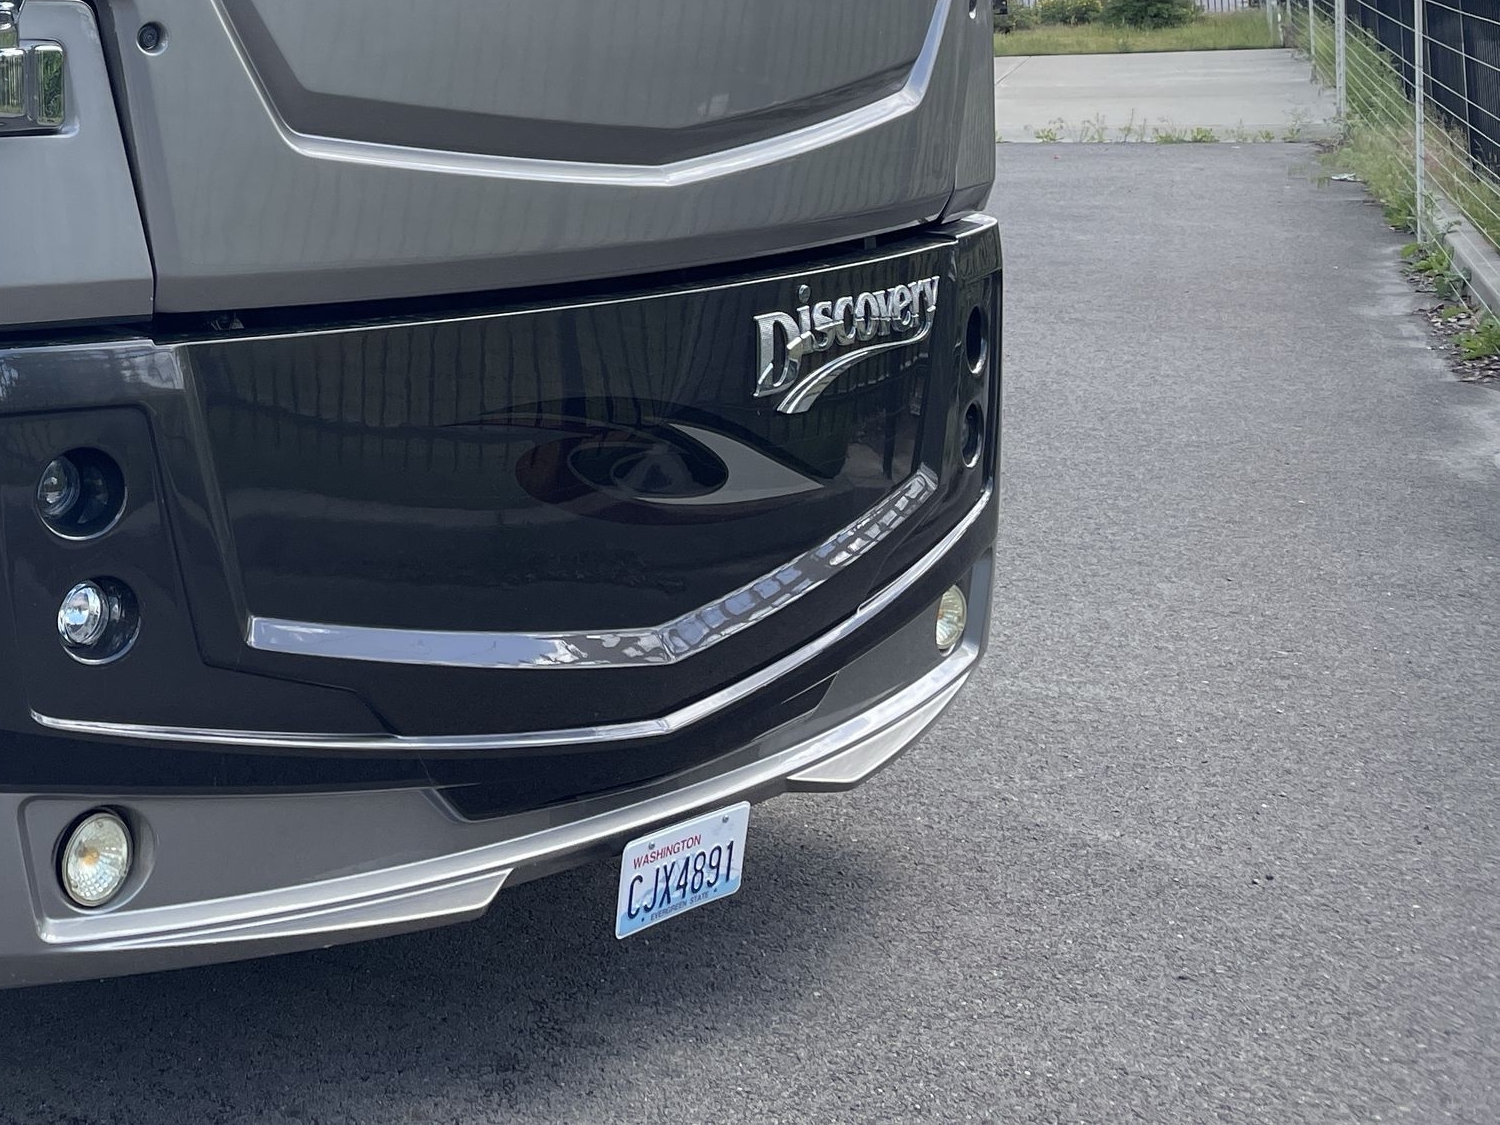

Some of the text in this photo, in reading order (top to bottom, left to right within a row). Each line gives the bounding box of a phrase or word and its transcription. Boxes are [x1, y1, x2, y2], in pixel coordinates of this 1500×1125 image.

[754, 276, 940, 398] Discovery
[627, 839, 734, 920] CJX4891
[633, 834, 702, 870] WASHINGTON
[650, 890, 709, 921] EVERGREEN STATE
